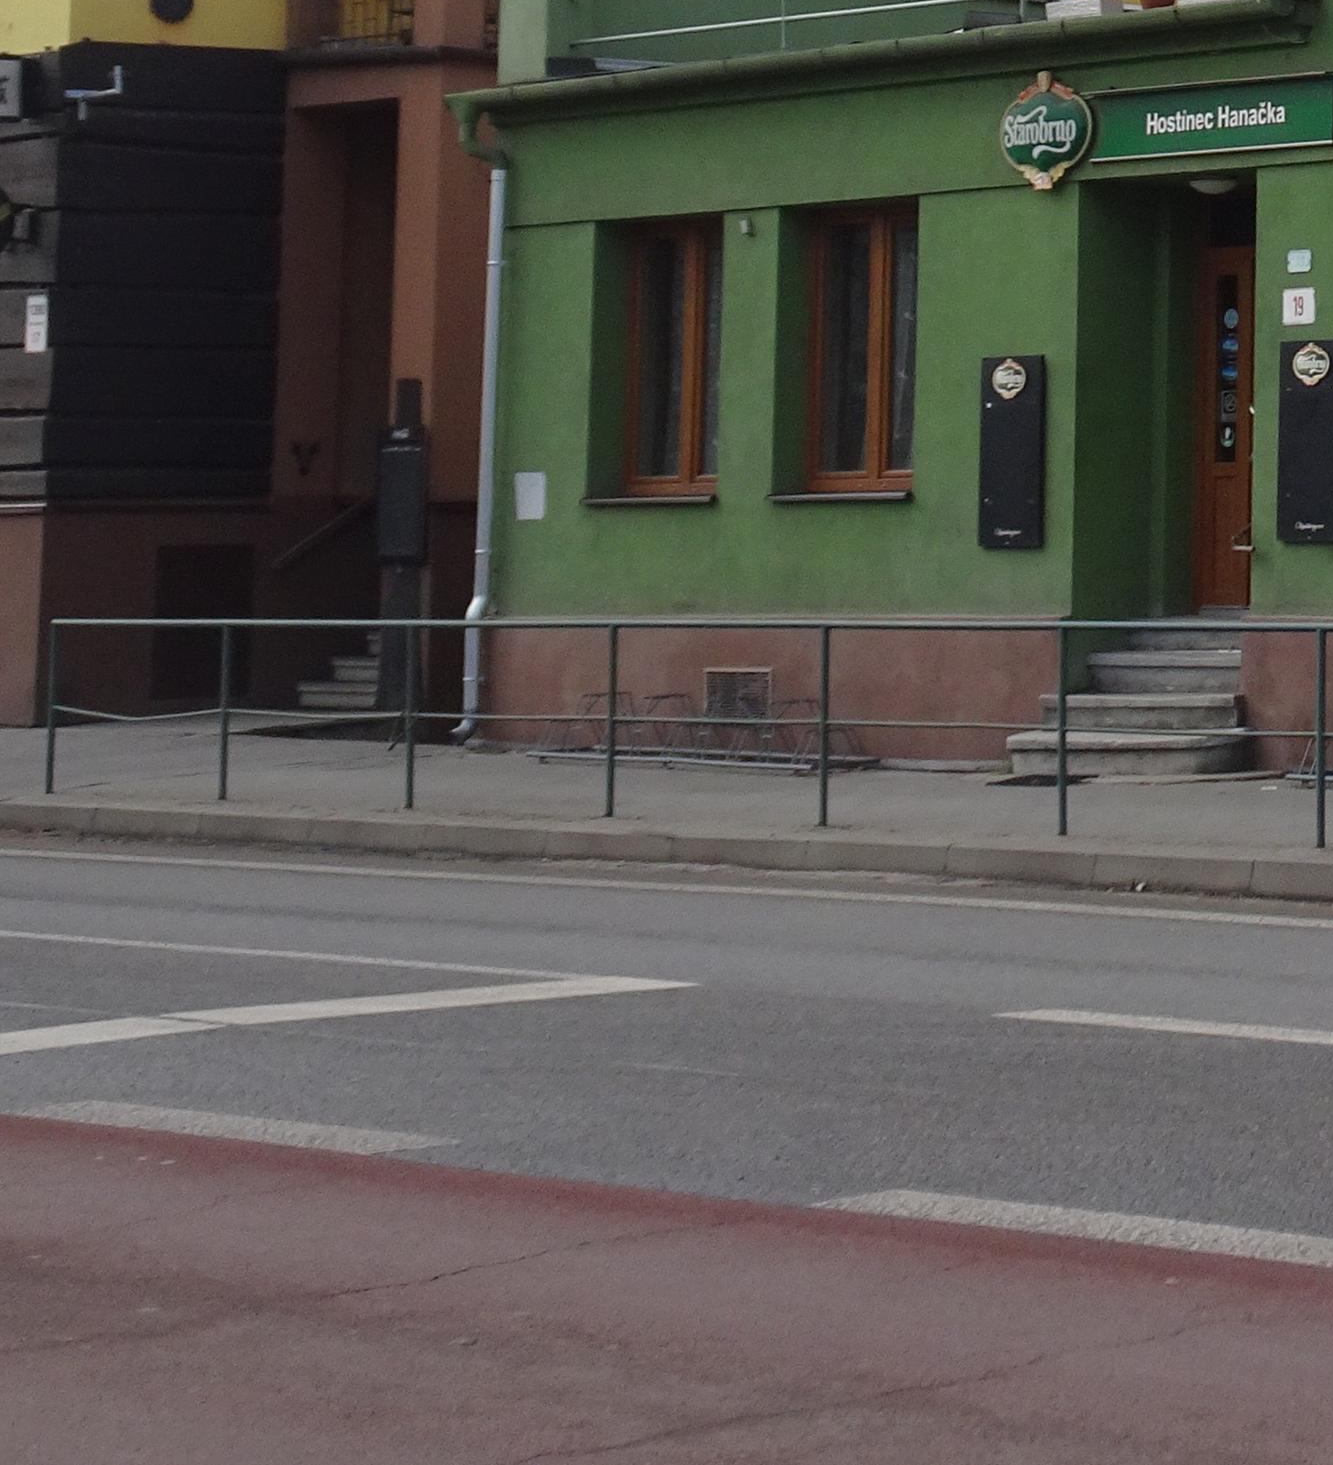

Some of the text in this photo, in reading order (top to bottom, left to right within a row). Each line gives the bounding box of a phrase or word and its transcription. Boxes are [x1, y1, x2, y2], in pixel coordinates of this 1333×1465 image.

[1004, 105, 1077, 159] Starobrno
[1146, 101, 1286, 135] Hostinec Hanačka
[1293, 296, 1304, 317] 19
